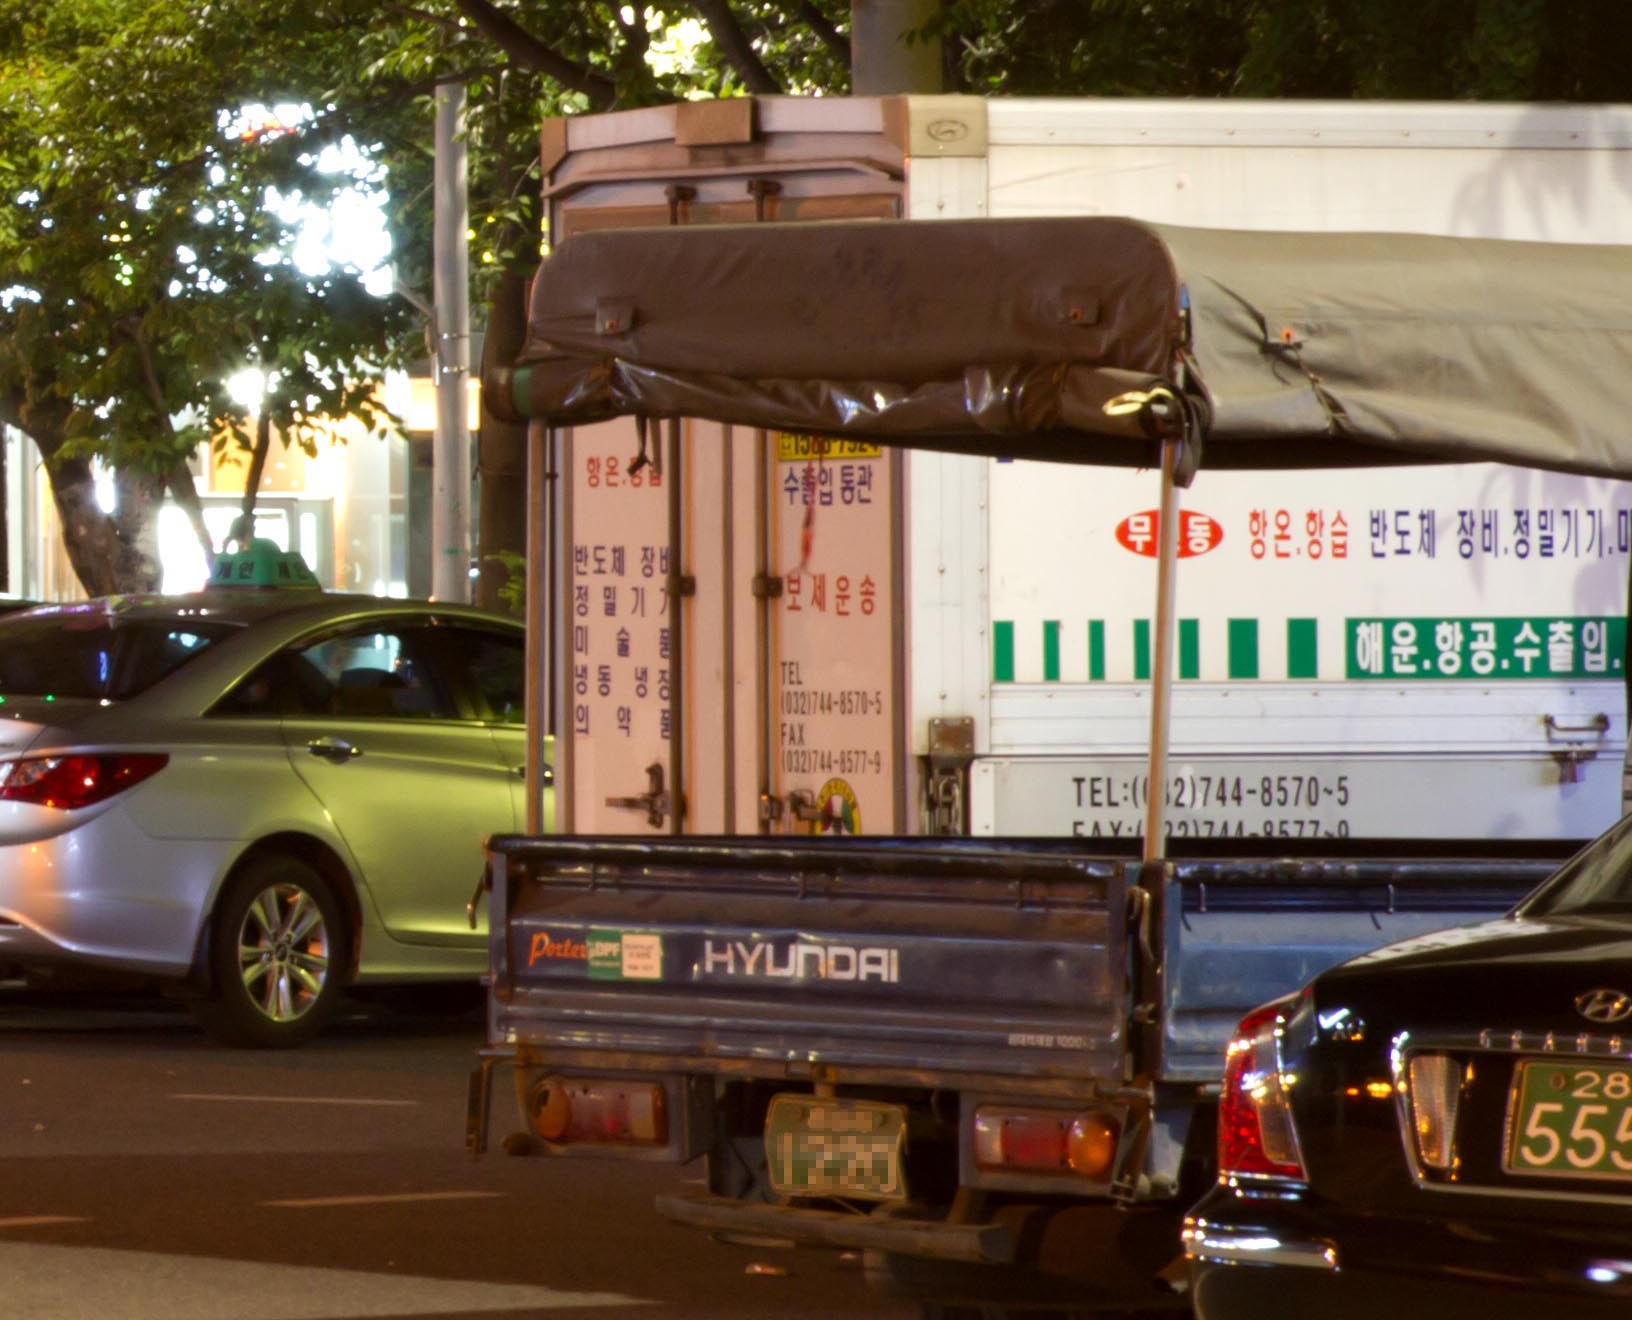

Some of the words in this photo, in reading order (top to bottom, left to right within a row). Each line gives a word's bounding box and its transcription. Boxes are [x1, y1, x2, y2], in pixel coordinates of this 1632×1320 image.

[840, 464, 873, 505] 통관
[1127, 514, 1211, 553] 무동
[1248, 508, 1348, 560] 항온.항습
[1369, 509, 1436, 559] 반도체
[575, 546, 625, 576] 반도체
[575, 625, 671, 659] 미술품
[1356, 621, 1623, 675] 해운.항공.수출입.
[575, 664, 611, 697] 냉동
[780, 661, 803, 685] TEL
[575, 705, 672, 740] 의약품
[780, 723, 805, 746] FAX
[704, 940, 899, 983] HYUNDAI
[1571, 1070, 1631, 1099] 28
